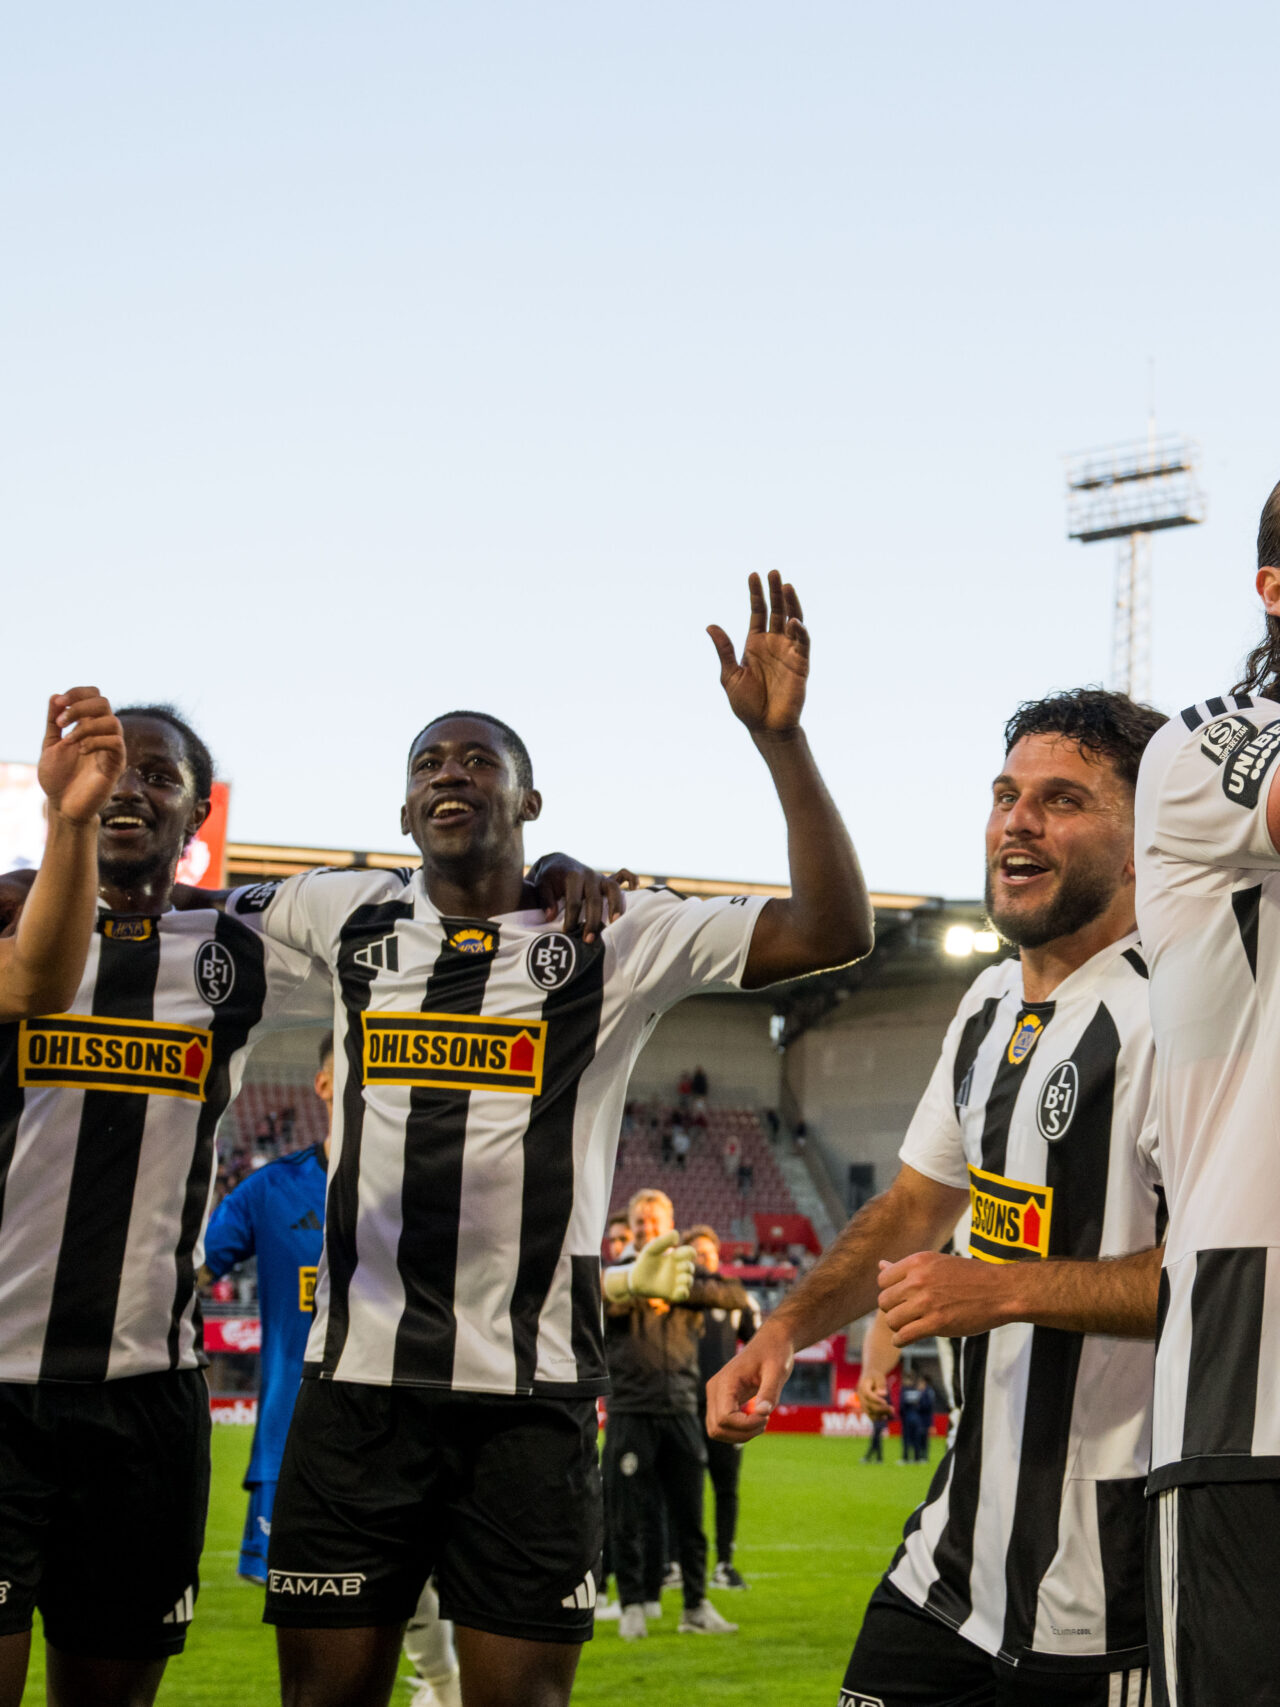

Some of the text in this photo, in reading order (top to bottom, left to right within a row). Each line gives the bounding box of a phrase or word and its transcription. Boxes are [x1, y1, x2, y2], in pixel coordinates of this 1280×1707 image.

[1219, 725, 1249, 760] SUPERETTAN
[29, 1034, 182, 1074] OHLSSONS
[369, 1033, 508, 1070] OHLSSONS
[972, 1195, 1020, 1242] SSONS
